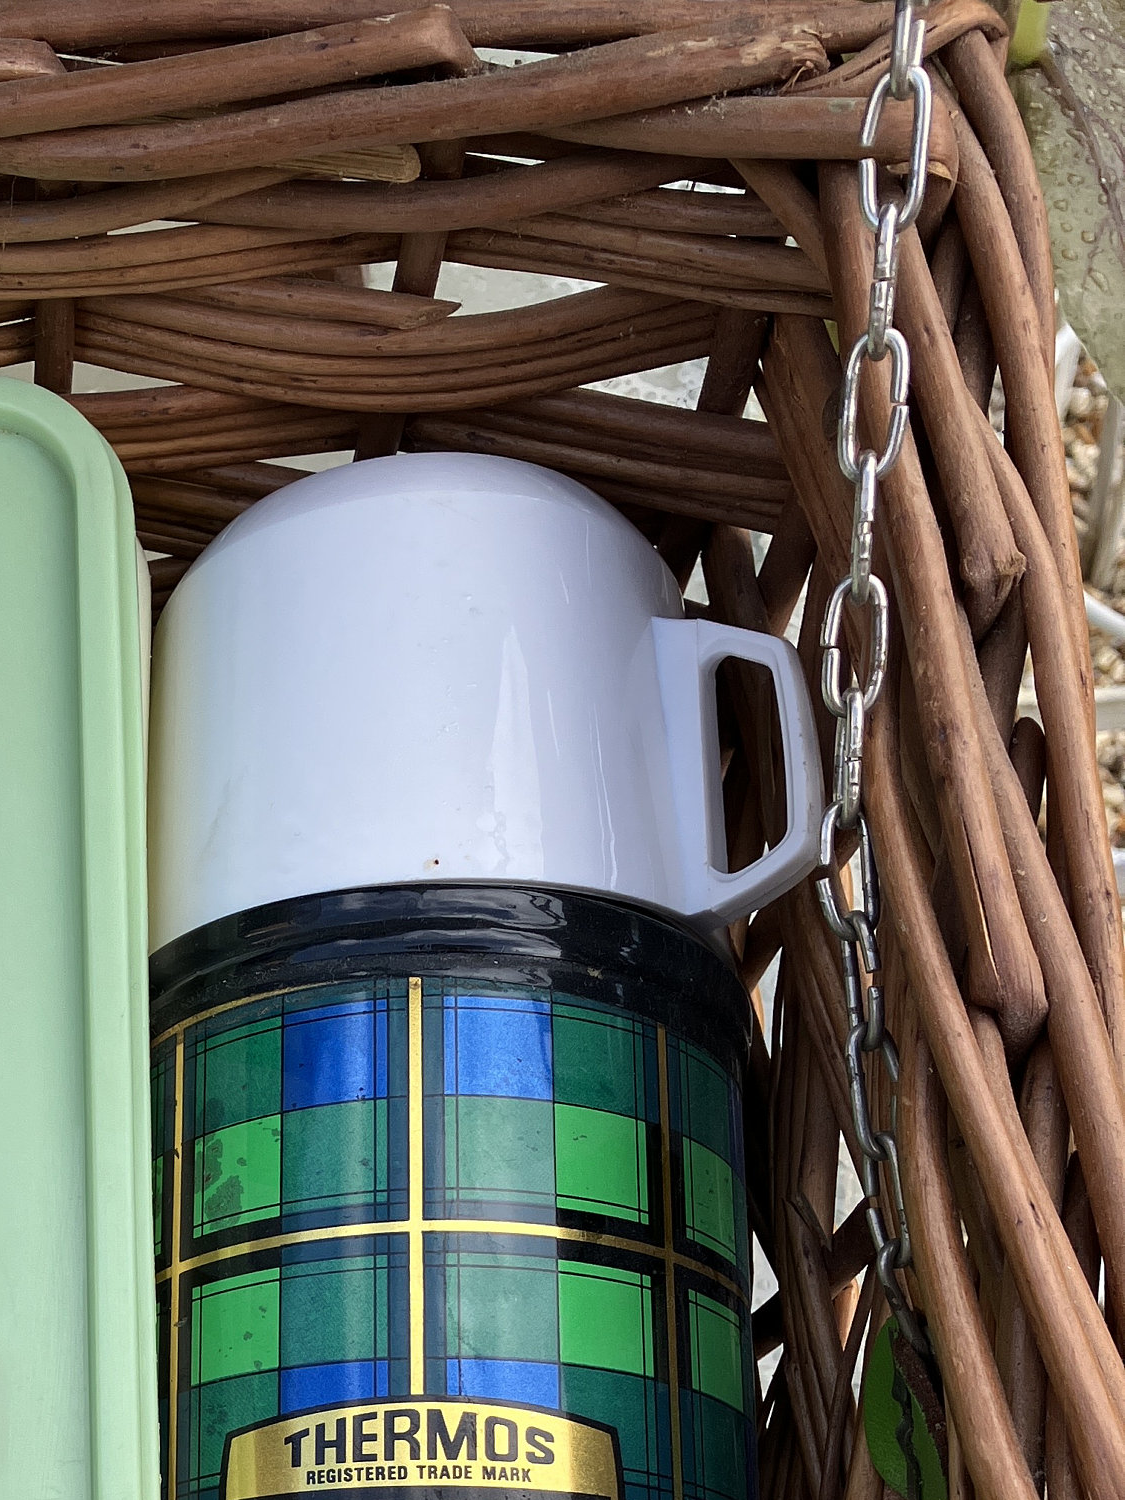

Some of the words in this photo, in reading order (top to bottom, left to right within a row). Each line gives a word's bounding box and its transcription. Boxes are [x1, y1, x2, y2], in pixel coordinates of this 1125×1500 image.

[284, 1408, 555, 1468] THERMOS
[306, 1465, 408, 1485] REGISTERED
[416, 1465, 473, 1480] TRADE
[482, 1465, 532, 1483] MARK
